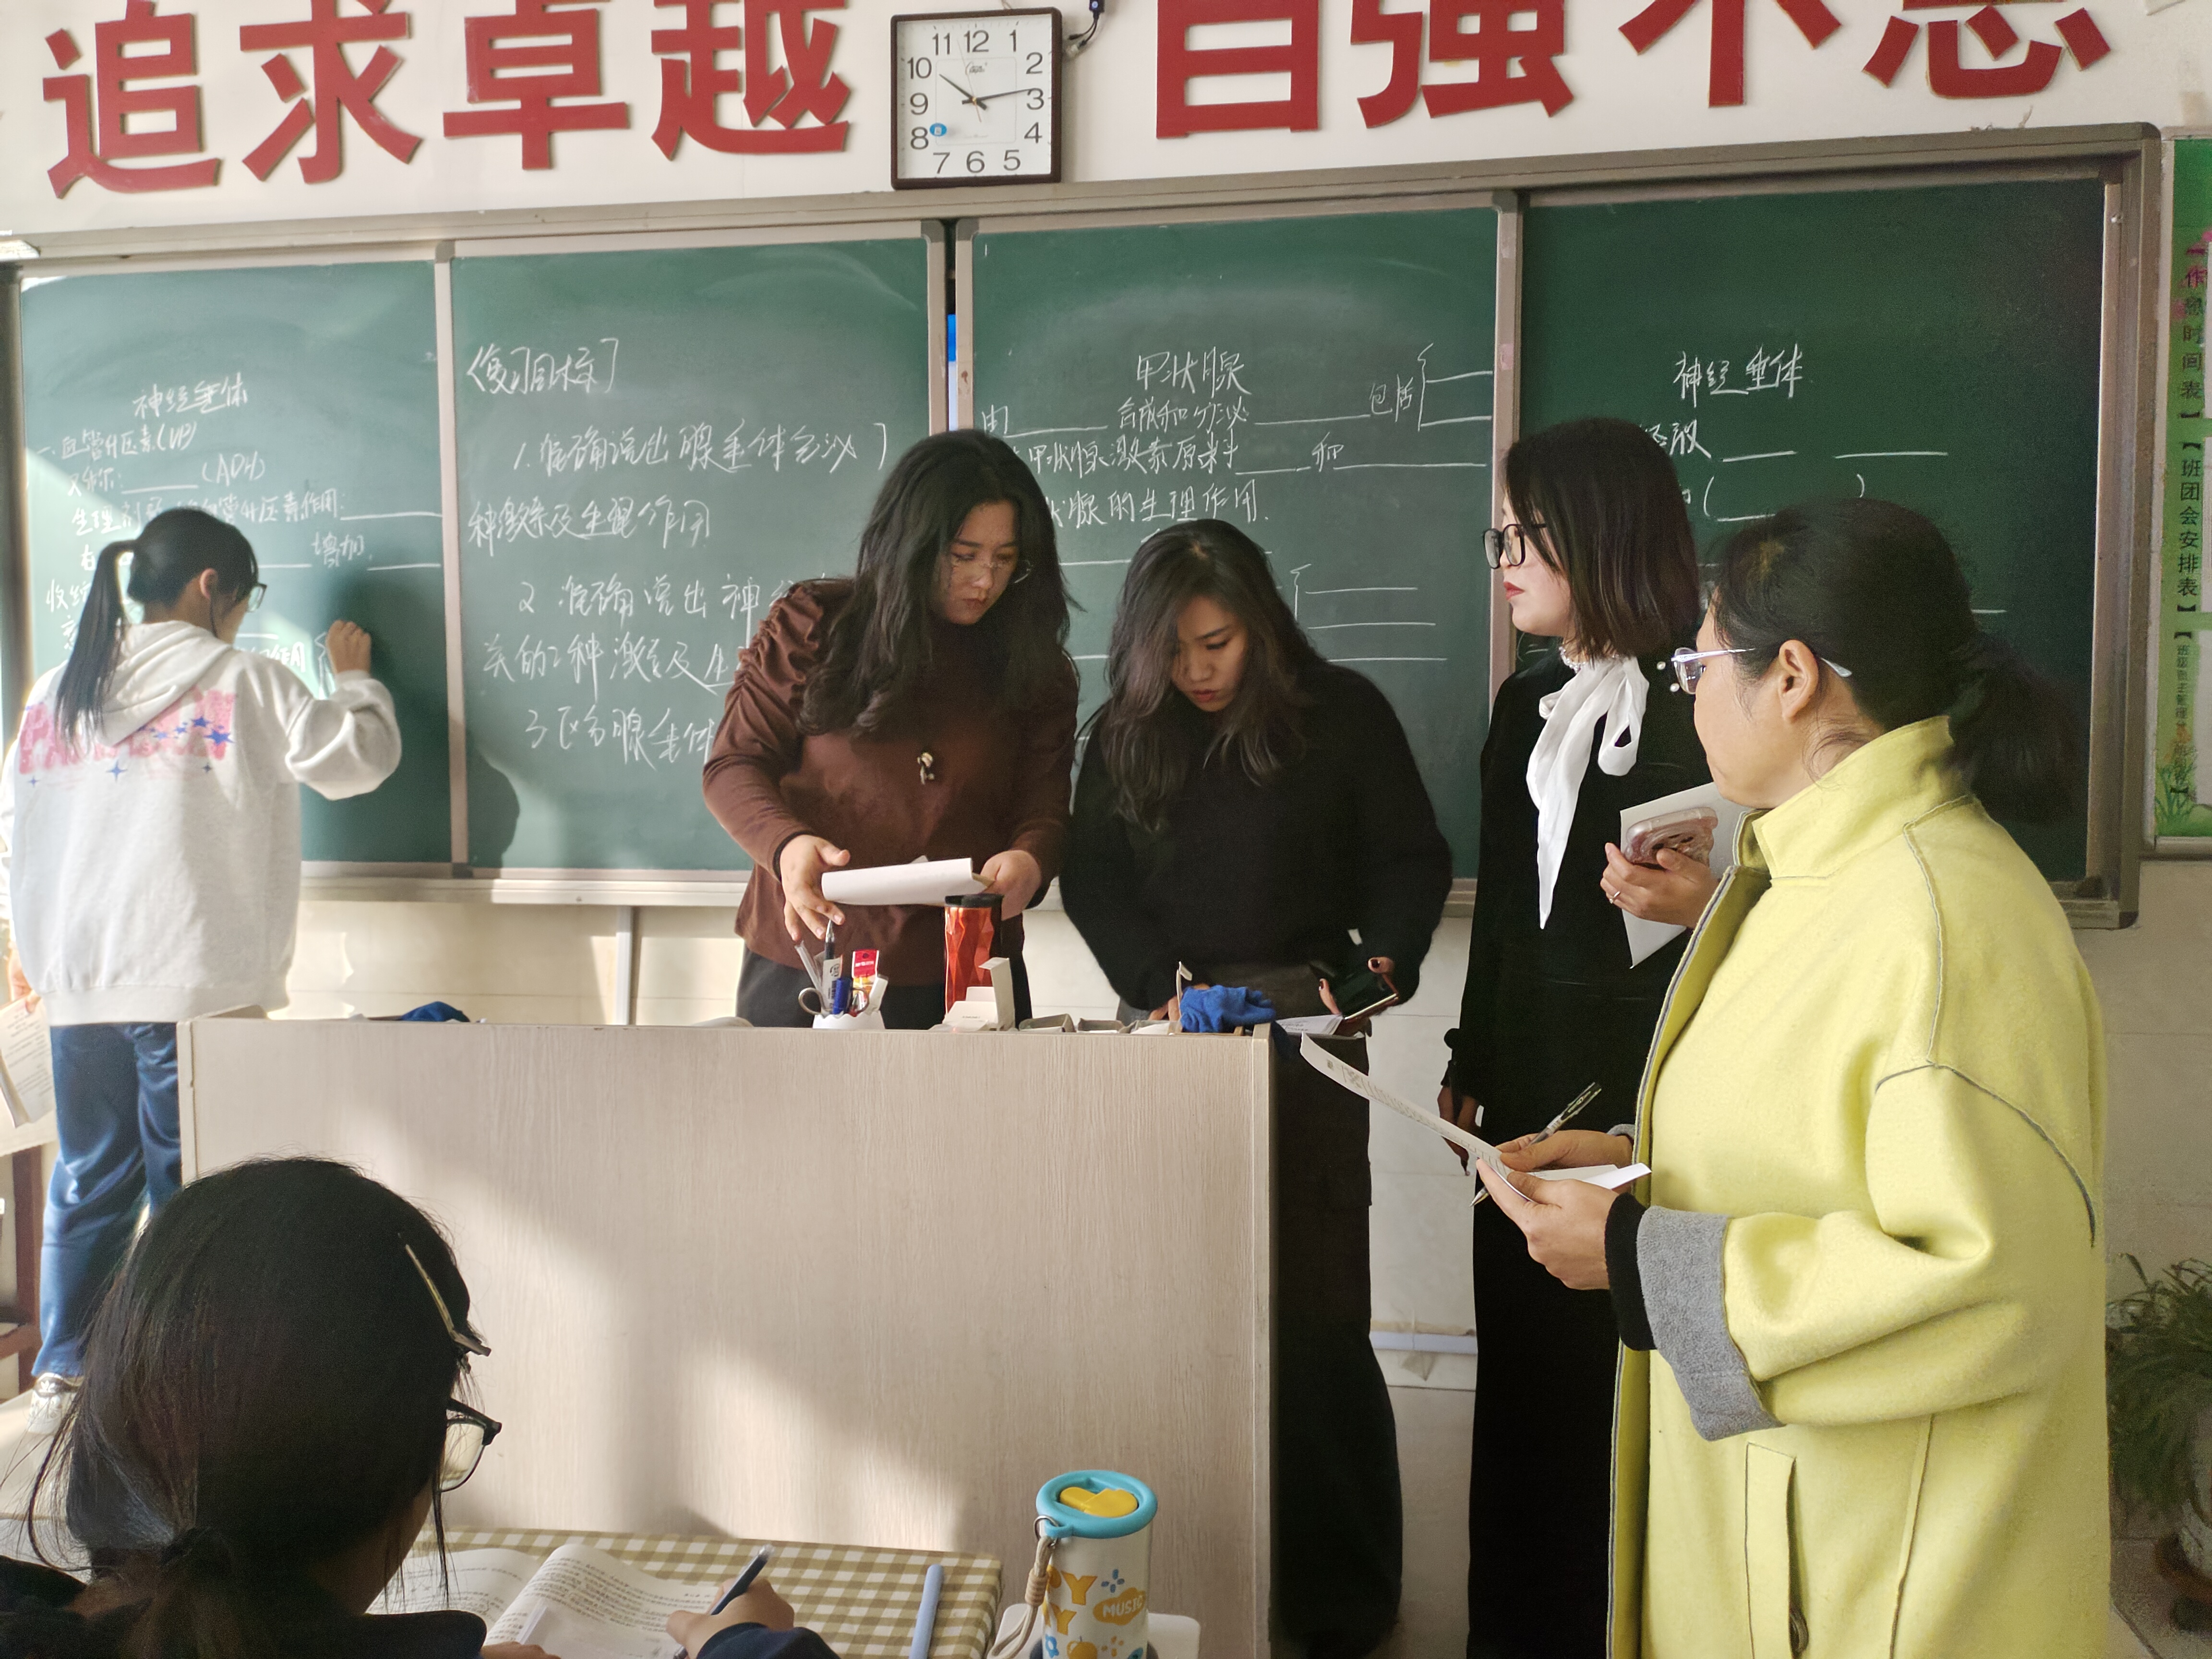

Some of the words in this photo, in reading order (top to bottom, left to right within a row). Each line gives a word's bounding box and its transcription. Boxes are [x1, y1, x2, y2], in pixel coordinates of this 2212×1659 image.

[932, 33, 950, 56] 11
[963, 30, 989, 53] 12
[1009, 30, 1017, 52] 1
[908, 57, 932, 79] 10
[1025, 52, 1043, 74] 2
[42, 0, 853, 198] 追求卓越
[910, 92, 928, 115] 9
[1026, 88, 1045, 110] 3
[910, 127, 929, 150] 8
[1024, 122, 1042, 144] 4
[933, 152, 950, 174] 7
[966, 151, 985, 173] 6
[1003, 149, 1021, 171] 5
[1136, 346, 1252, 396] 甲状腺
[1673, 343, 1803, 408] 神经垂体
[132, 371, 248, 419] 神经垂体
[1103, 1595, 1144, 1618] MUSIC
